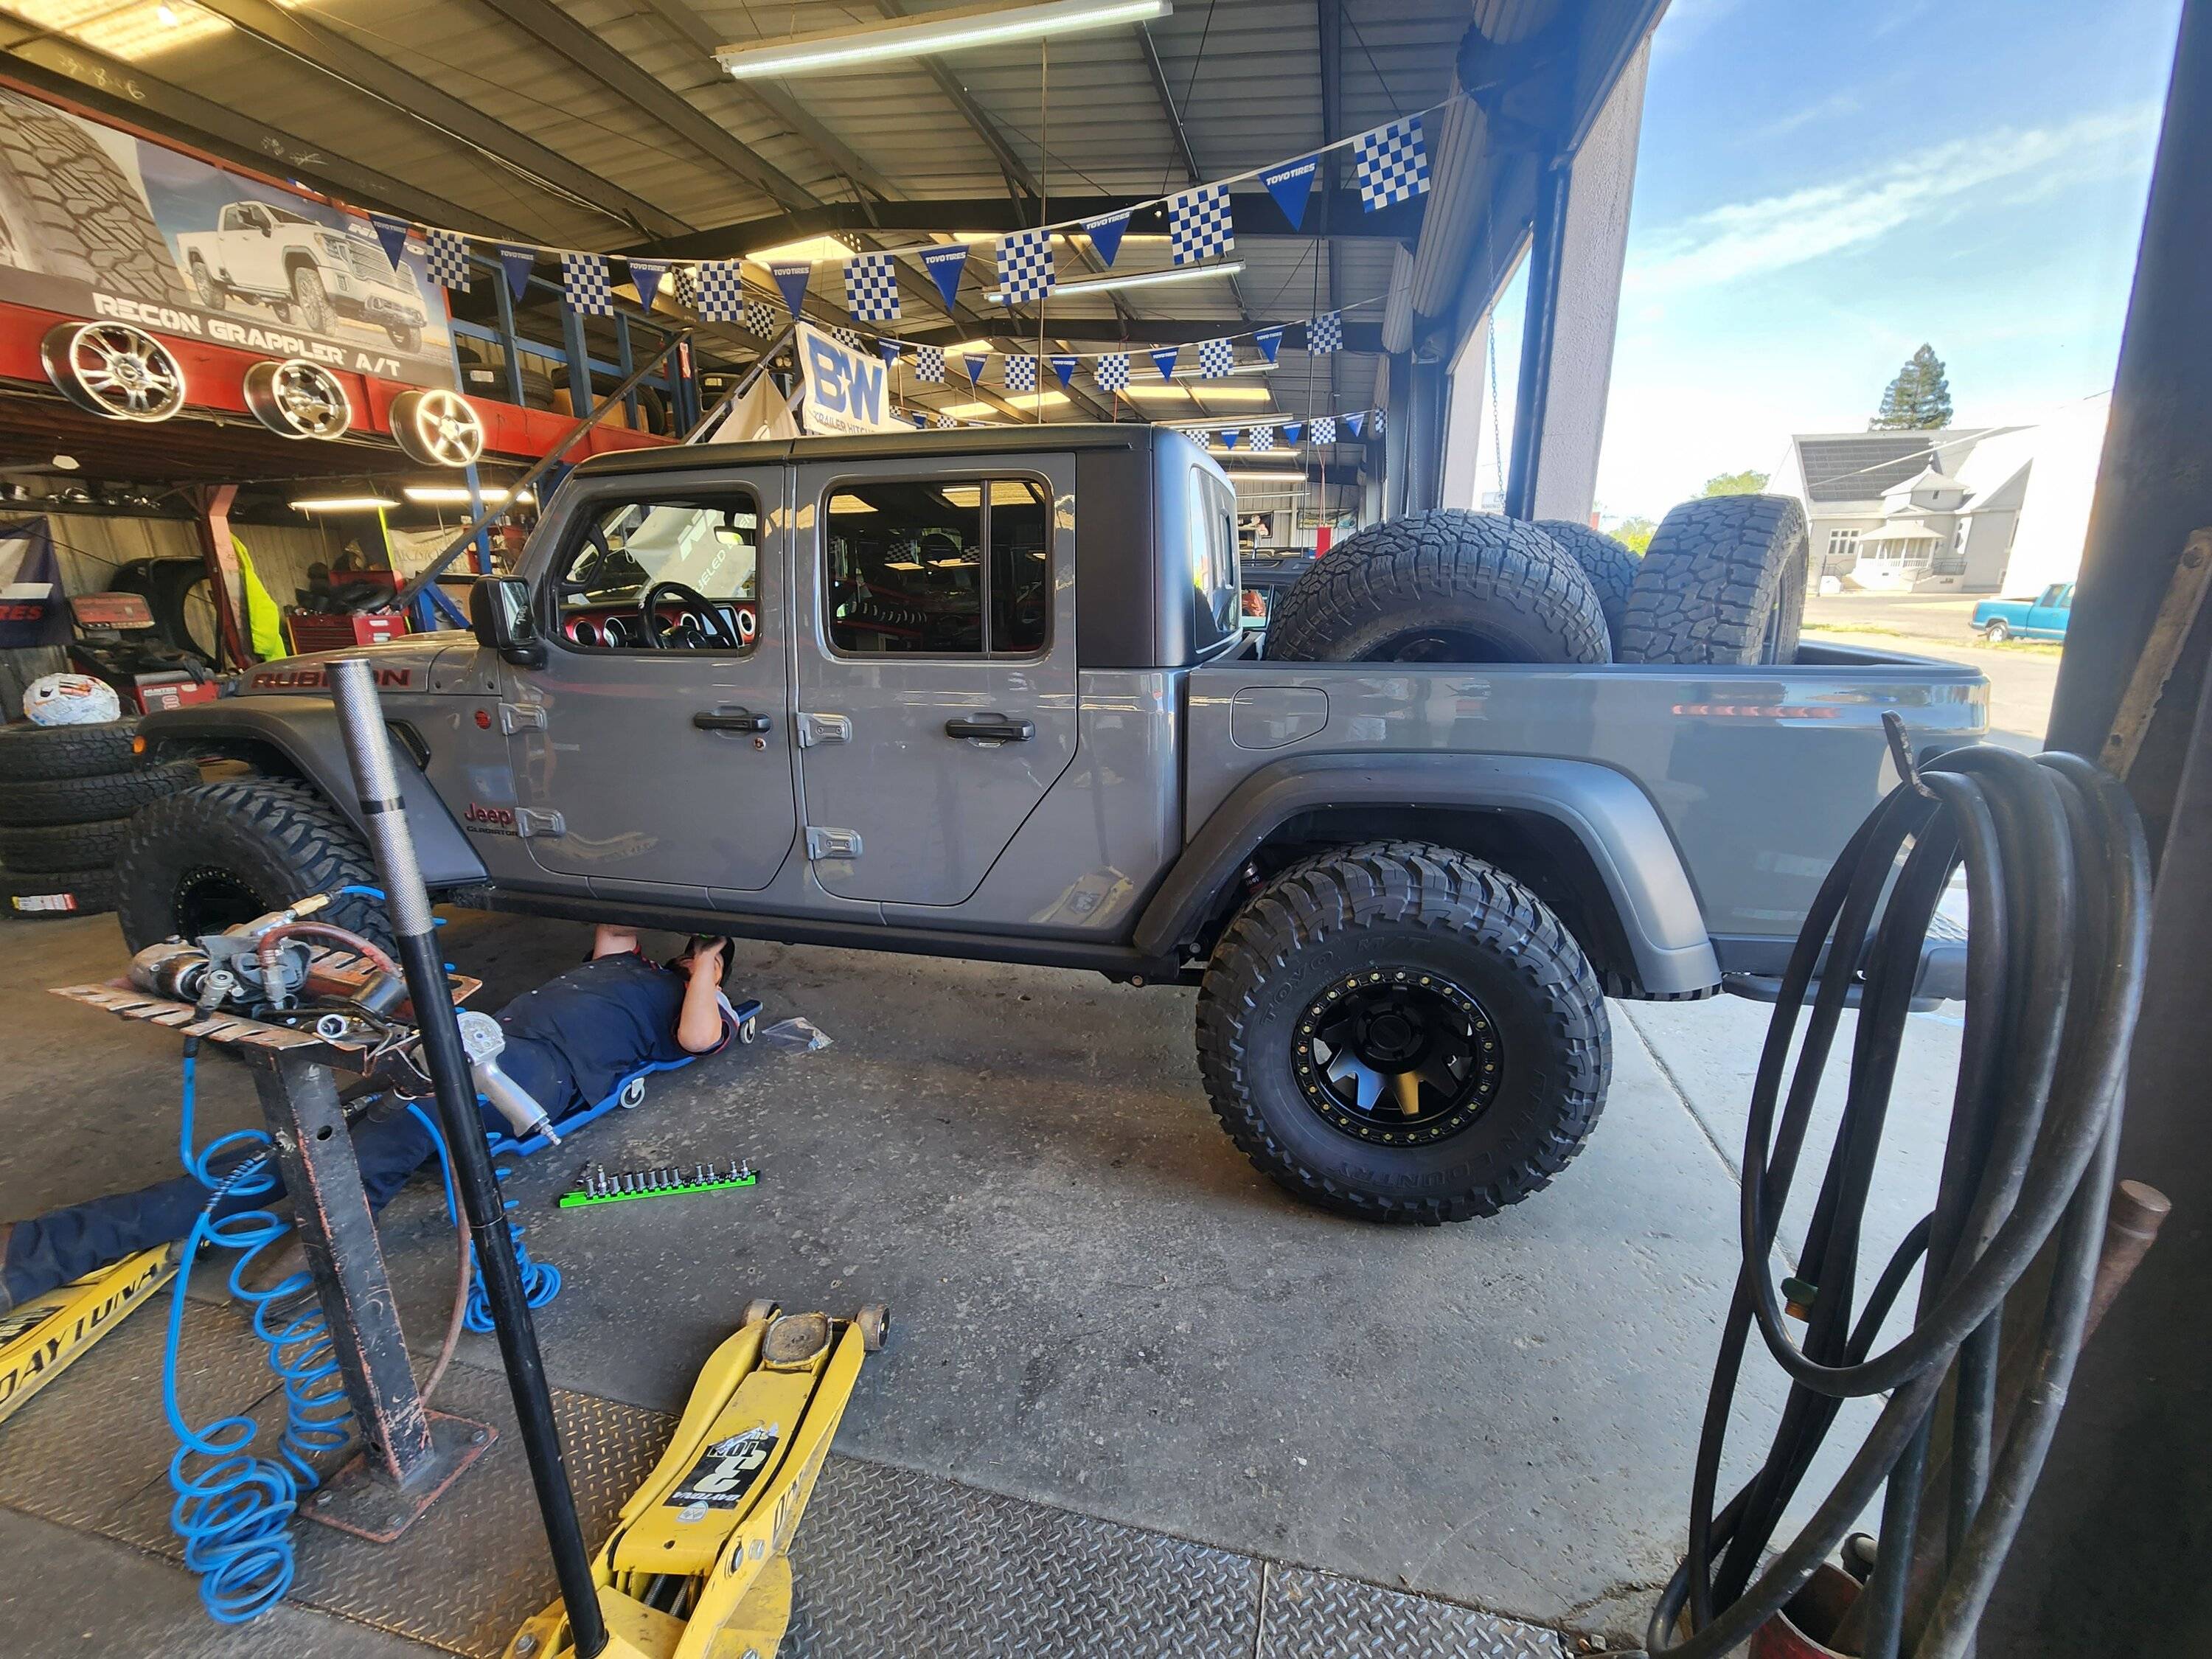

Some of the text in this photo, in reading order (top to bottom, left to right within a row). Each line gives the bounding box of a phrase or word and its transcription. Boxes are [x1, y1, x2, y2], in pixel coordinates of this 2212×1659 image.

[1265, 162, 1316, 186] TOYO TIRES
[1086, 211, 1130, 230] TOYO TIRES
[630, 262, 647, 271] TOYO
[925, 251, 967, 264] TOYO TIRES
[773, 266, 810, 276] TOYO TIRES
[92, 293, 401, 378] RECON GRAPPLER A/T
[692, 549, 726, 594] UELED
[251, 668, 411, 689] RUBIN
[464, 801, 512, 828] Jeep
[1258, 949, 1335, 1026] TOYO
[692, 1450, 768, 1493] 3
[672, 1491, 742, 1502] DAYTONA
